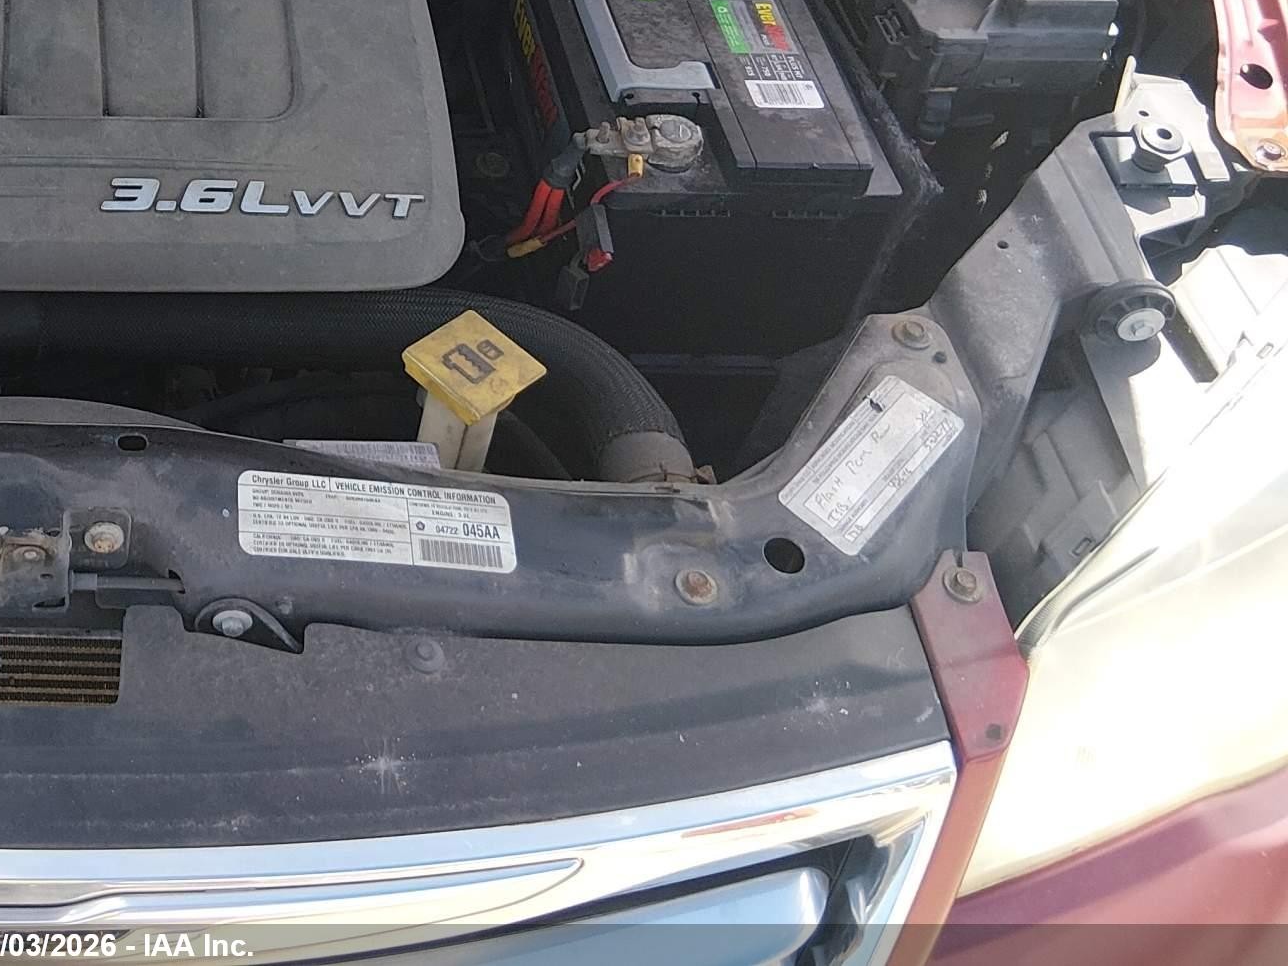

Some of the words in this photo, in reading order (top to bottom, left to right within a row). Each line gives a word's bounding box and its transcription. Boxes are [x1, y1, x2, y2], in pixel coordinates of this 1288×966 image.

[252, 474, 283, 487] Chrysler
[286, 476, 309, 488] Group
[312, 479, 327, 489] LLC
[335, 481, 367, 493] VEHICLE
[369, 484, 405, 496] EMISSION
[407, 488, 442, 500] CONTROL
[444, 491, 497, 505] INFORMATION
[435, 525, 459, 535] 04722
[462, 522, 501, 540] 045AA
